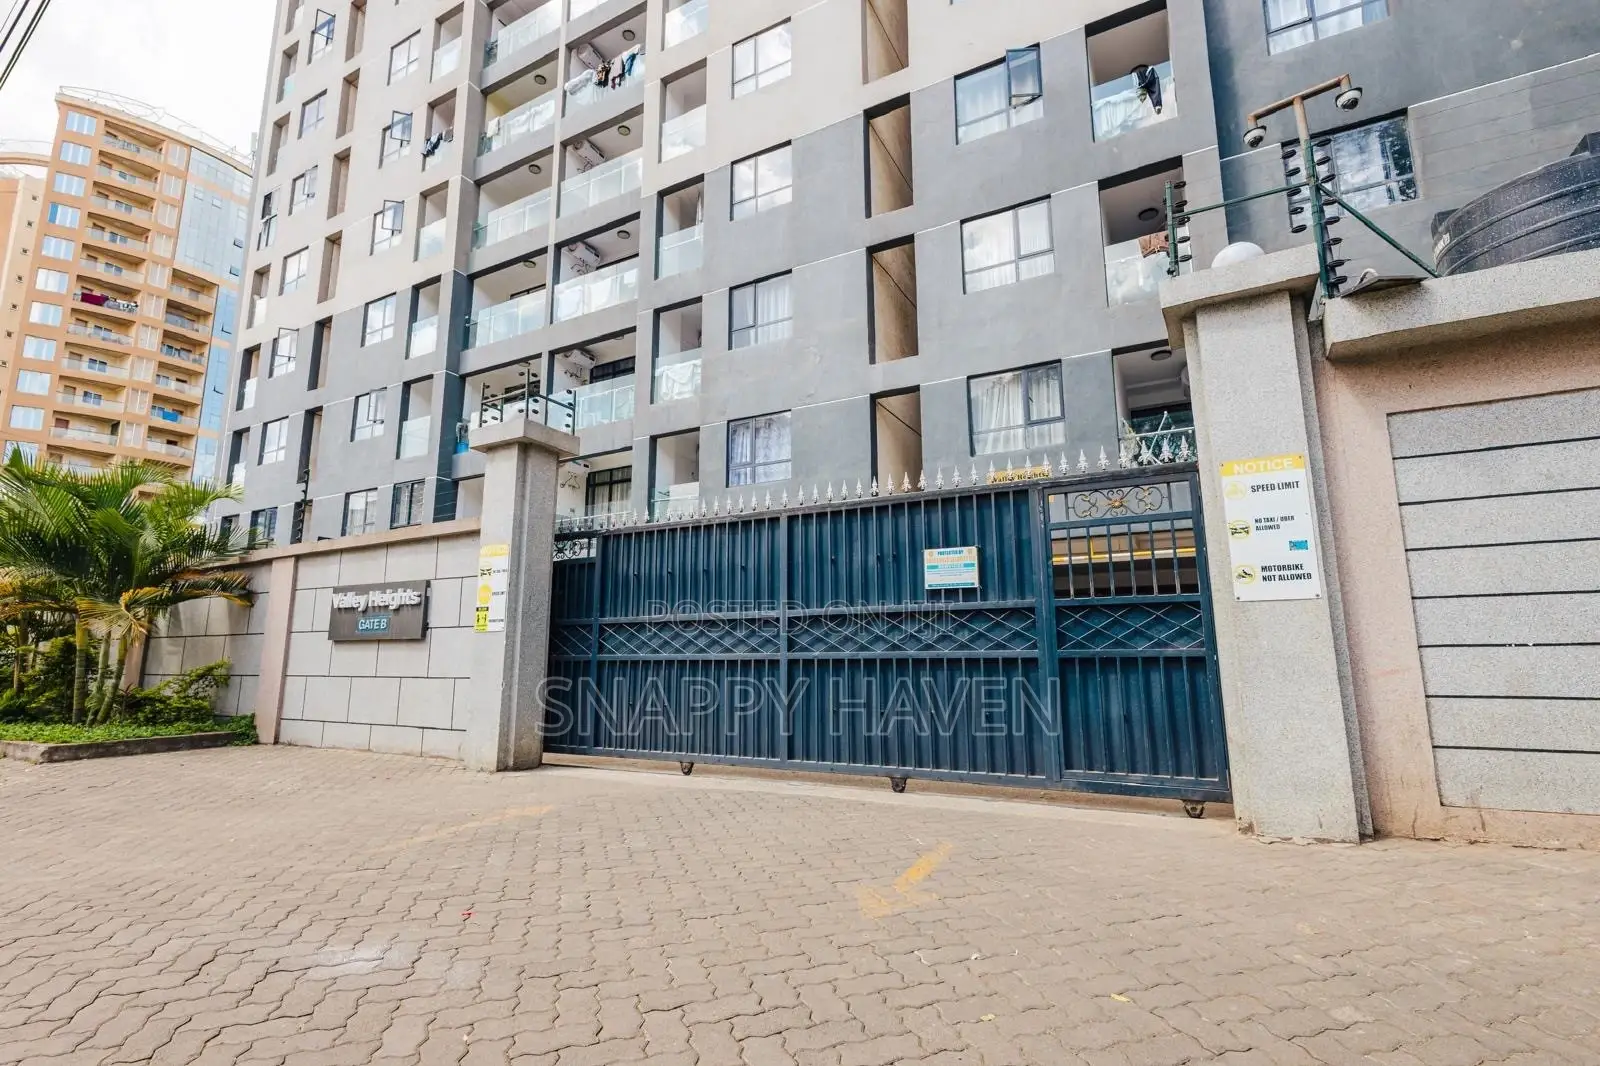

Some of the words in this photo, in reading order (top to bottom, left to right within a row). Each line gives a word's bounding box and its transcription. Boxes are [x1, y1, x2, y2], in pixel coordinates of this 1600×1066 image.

[1233, 458, 1293, 474] NOTICE
[1250, 482, 1275, 493] SPEED
[1277, 480, 1300, 491] LIMIT
[1261, 563, 1304, 573] MOTORBIKE
[1262, 574, 1276, 582] NOT
[1278, 572, 1312, 581] ALLOWED
[332, 591, 368, 611] Valley
[368, 587, 421, 610] Heights
[358, 619, 380, 630] GATE
[380, 618, 387, 629] B
